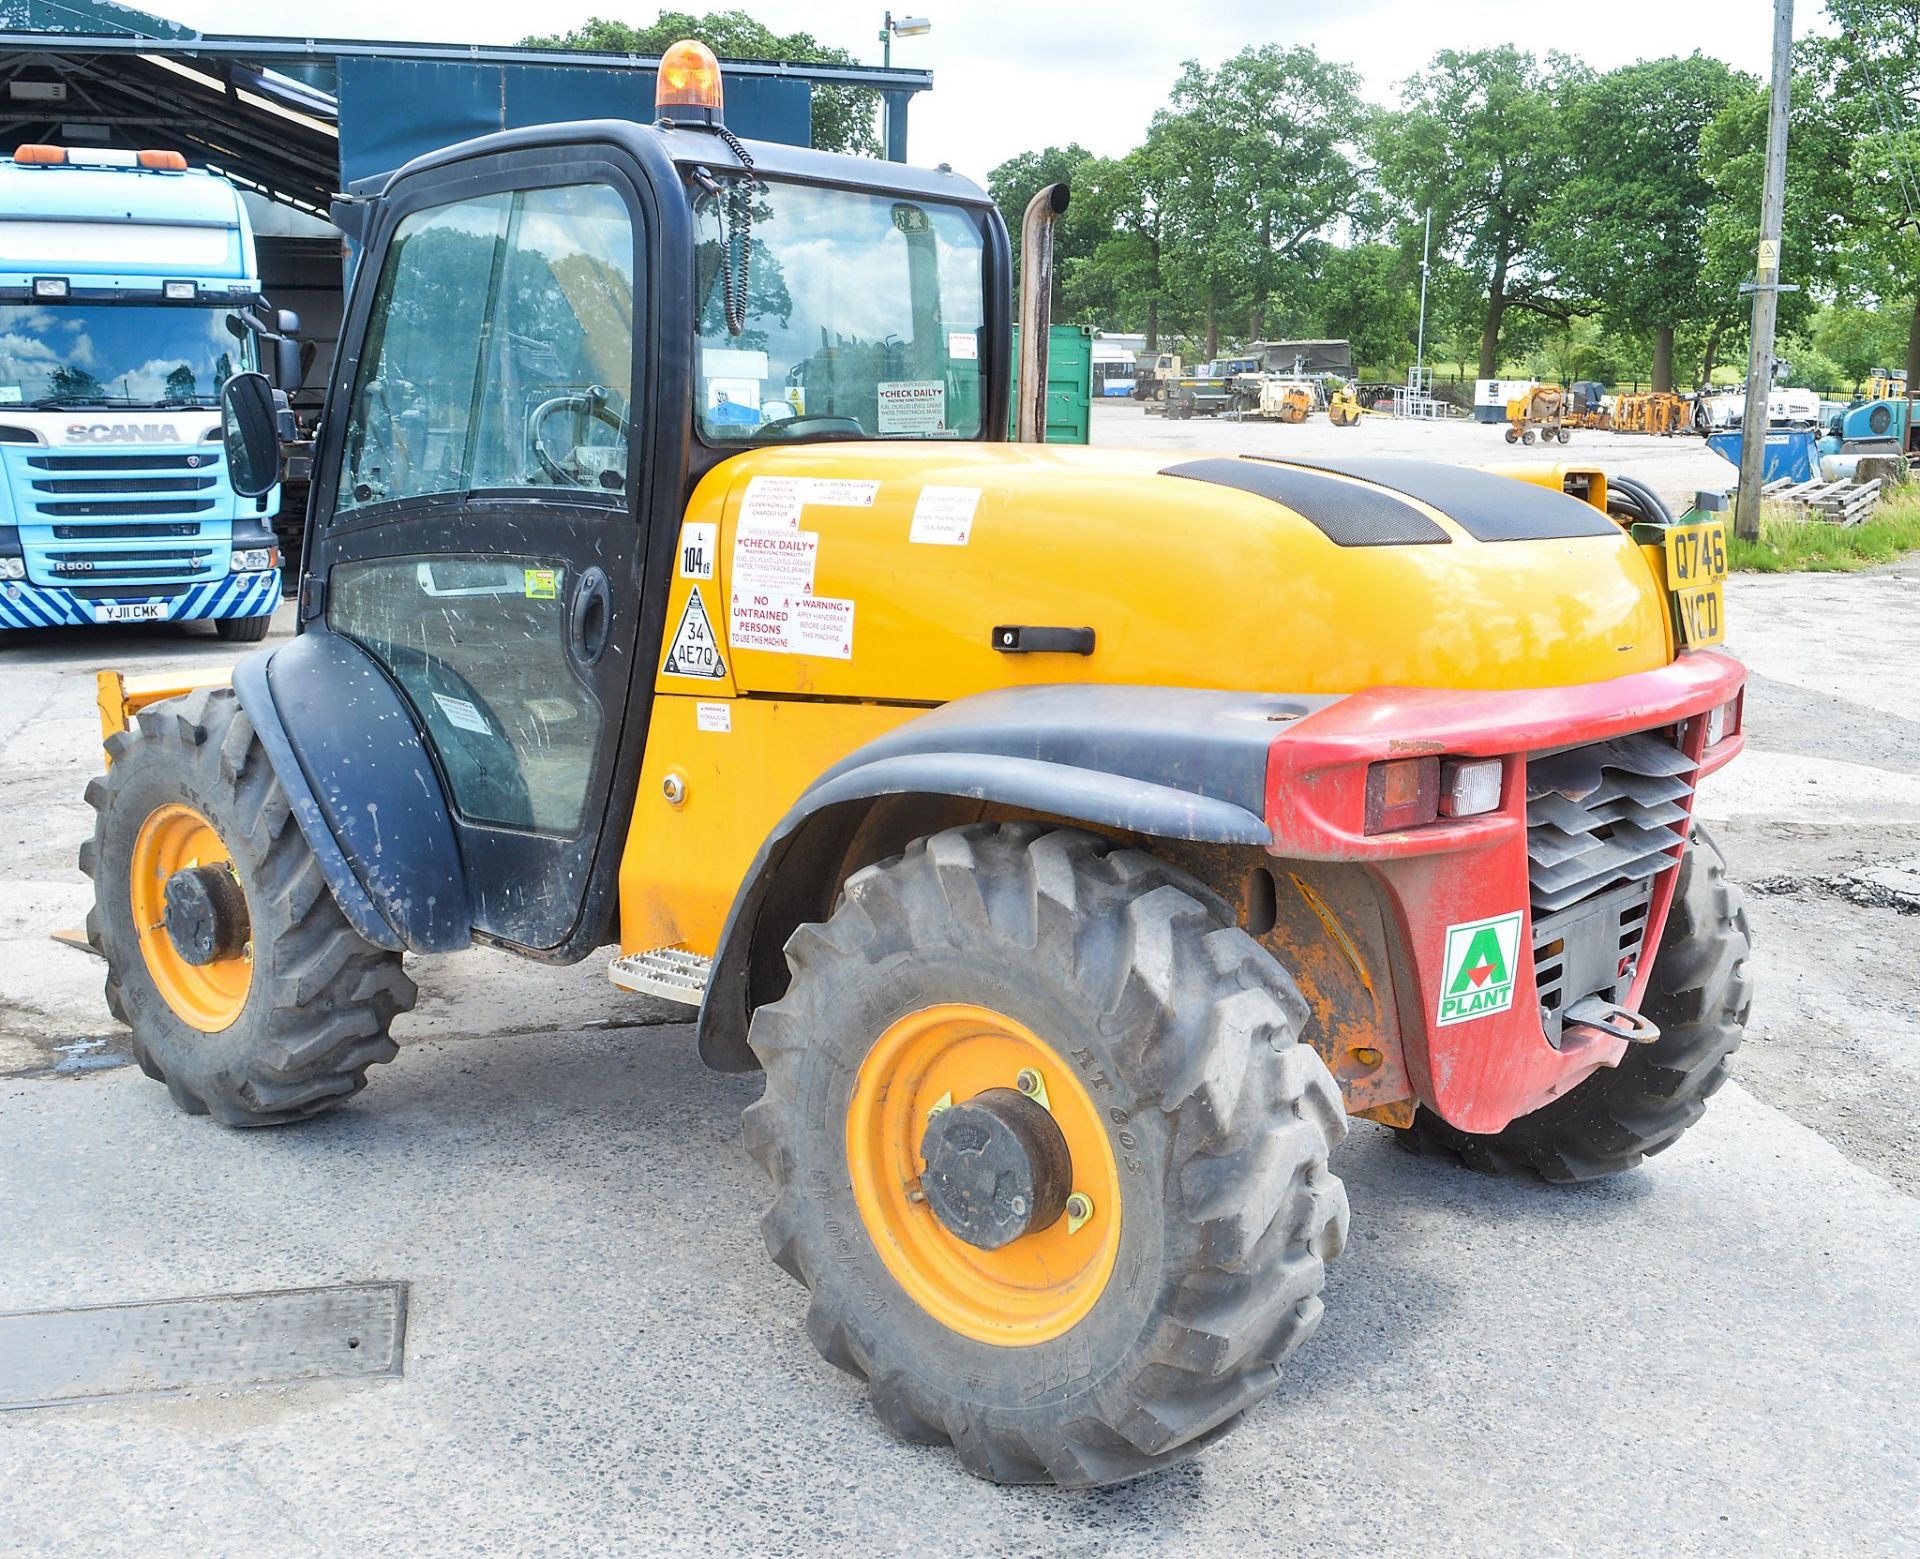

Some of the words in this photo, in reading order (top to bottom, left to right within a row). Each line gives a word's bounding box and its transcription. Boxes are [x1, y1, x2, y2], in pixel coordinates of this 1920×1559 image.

[885, 390, 912, 398] CHECK
[914, 389, 937, 397] DAILY
[65, 424, 181, 442] SCANIA
[743, 538, 776, 549] CHECK
[778, 540, 808, 551] DAILY
[684, 546, 703, 573] 104
[1675, 530, 1724, 579] Q746
[754, 596, 768, 606] NO
[802, 599, 843, 611] WARNING
[107, 607, 130, 618] YJ11
[133, 605, 158, 617] CMK
[733, 607, 788, 622] UNTRAINED
[813, 613, 847, 623] HANDBRAKE
[1684, 592, 1718, 641] VCD
[687, 622, 704, 641] 34
[740, 621, 781, 635] PERSONS
[799, 621, 819, 630] BEFORE
[732, 633, 739, 642] TO
[741, 634, 750, 643] USE
[752, 635, 763, 645] THIS
[764, 636, 788, 647] MACHINE
[802, 631, 814, 639] THIS
[815, 632, 840, 642] MACHINE
[678, 645, 712, 665] AE7Q
[1449, 927, 1508, 994] A
[1441, 985, 1511, 1018] PLANT
[1110, 1107, 1145, 1176] 603
